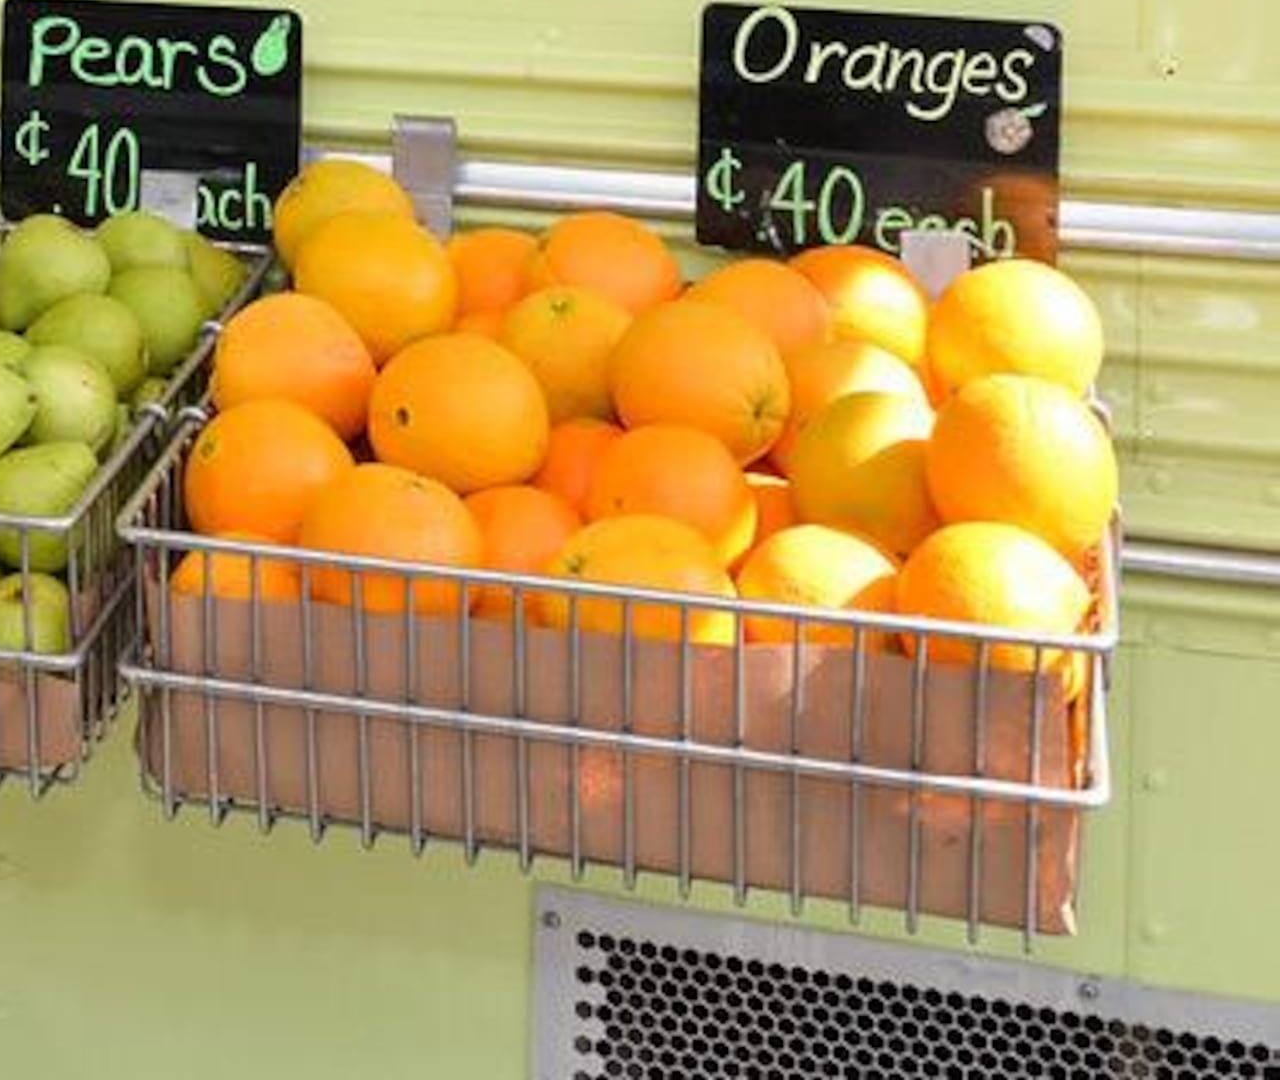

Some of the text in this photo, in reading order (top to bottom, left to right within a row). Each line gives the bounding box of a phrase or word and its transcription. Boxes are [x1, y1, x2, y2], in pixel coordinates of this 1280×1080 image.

[29, 16, 248, 96] Pears
[733, 5, 1036, 120] Oranges
[197, 162, 273, 232] ach
